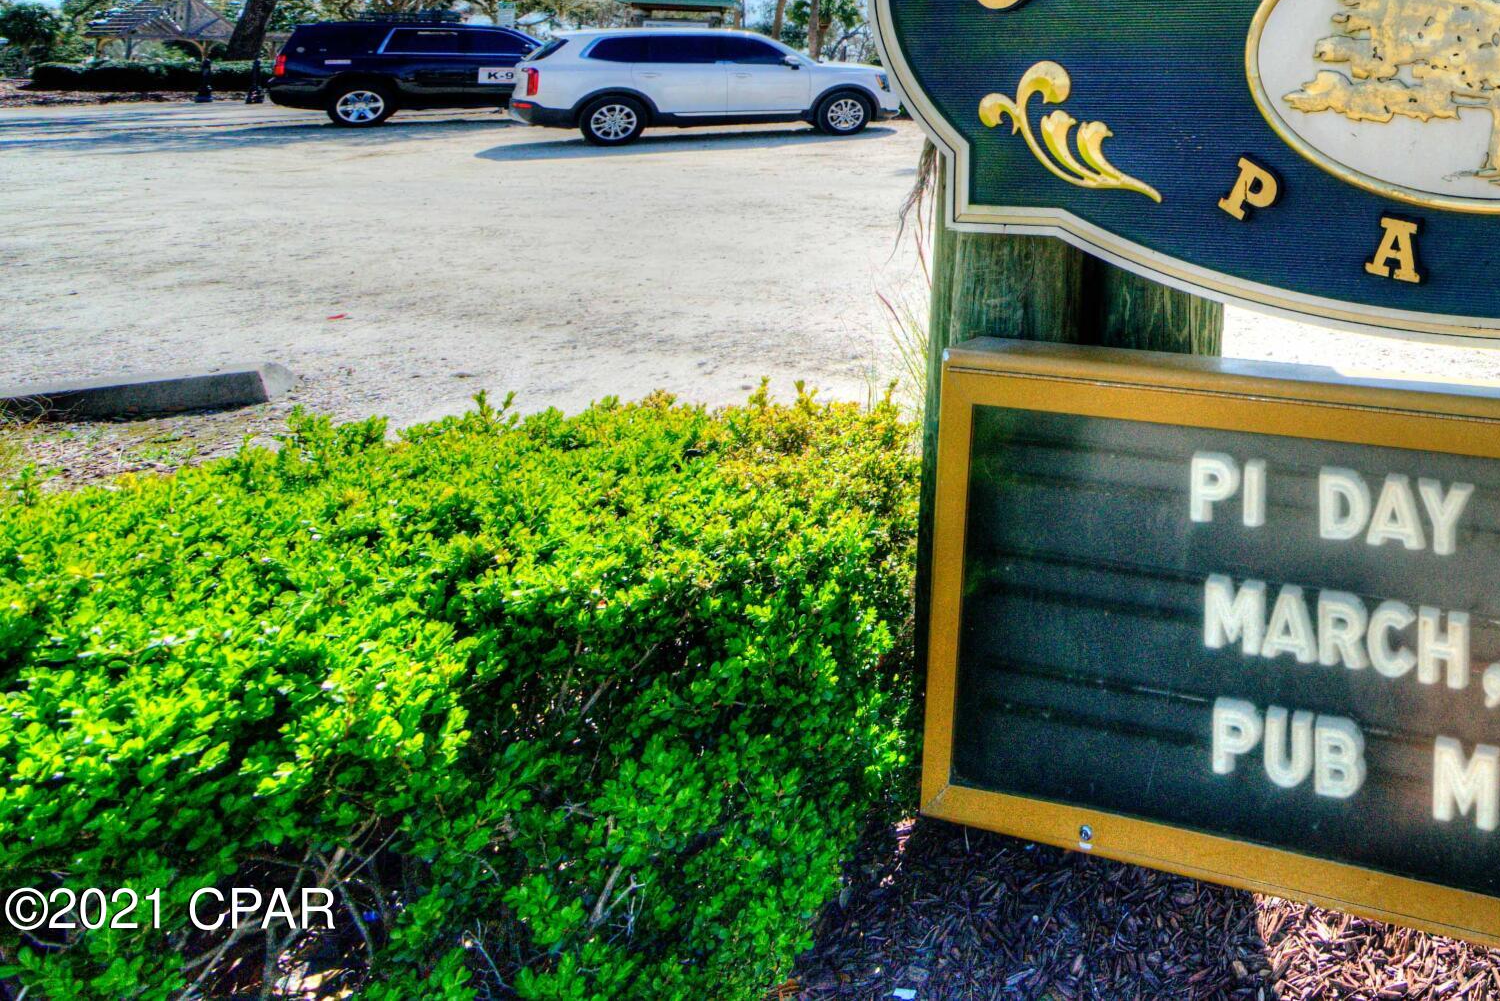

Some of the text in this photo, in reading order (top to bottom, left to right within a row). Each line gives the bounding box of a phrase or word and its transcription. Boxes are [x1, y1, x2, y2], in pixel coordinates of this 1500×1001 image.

[487, 71, 515, 81] K-9
[1189, 451, 1267, 528] PI
[1318, 465, 1475, 556] DAY
[1211, 695, 1368, 799] PUB
